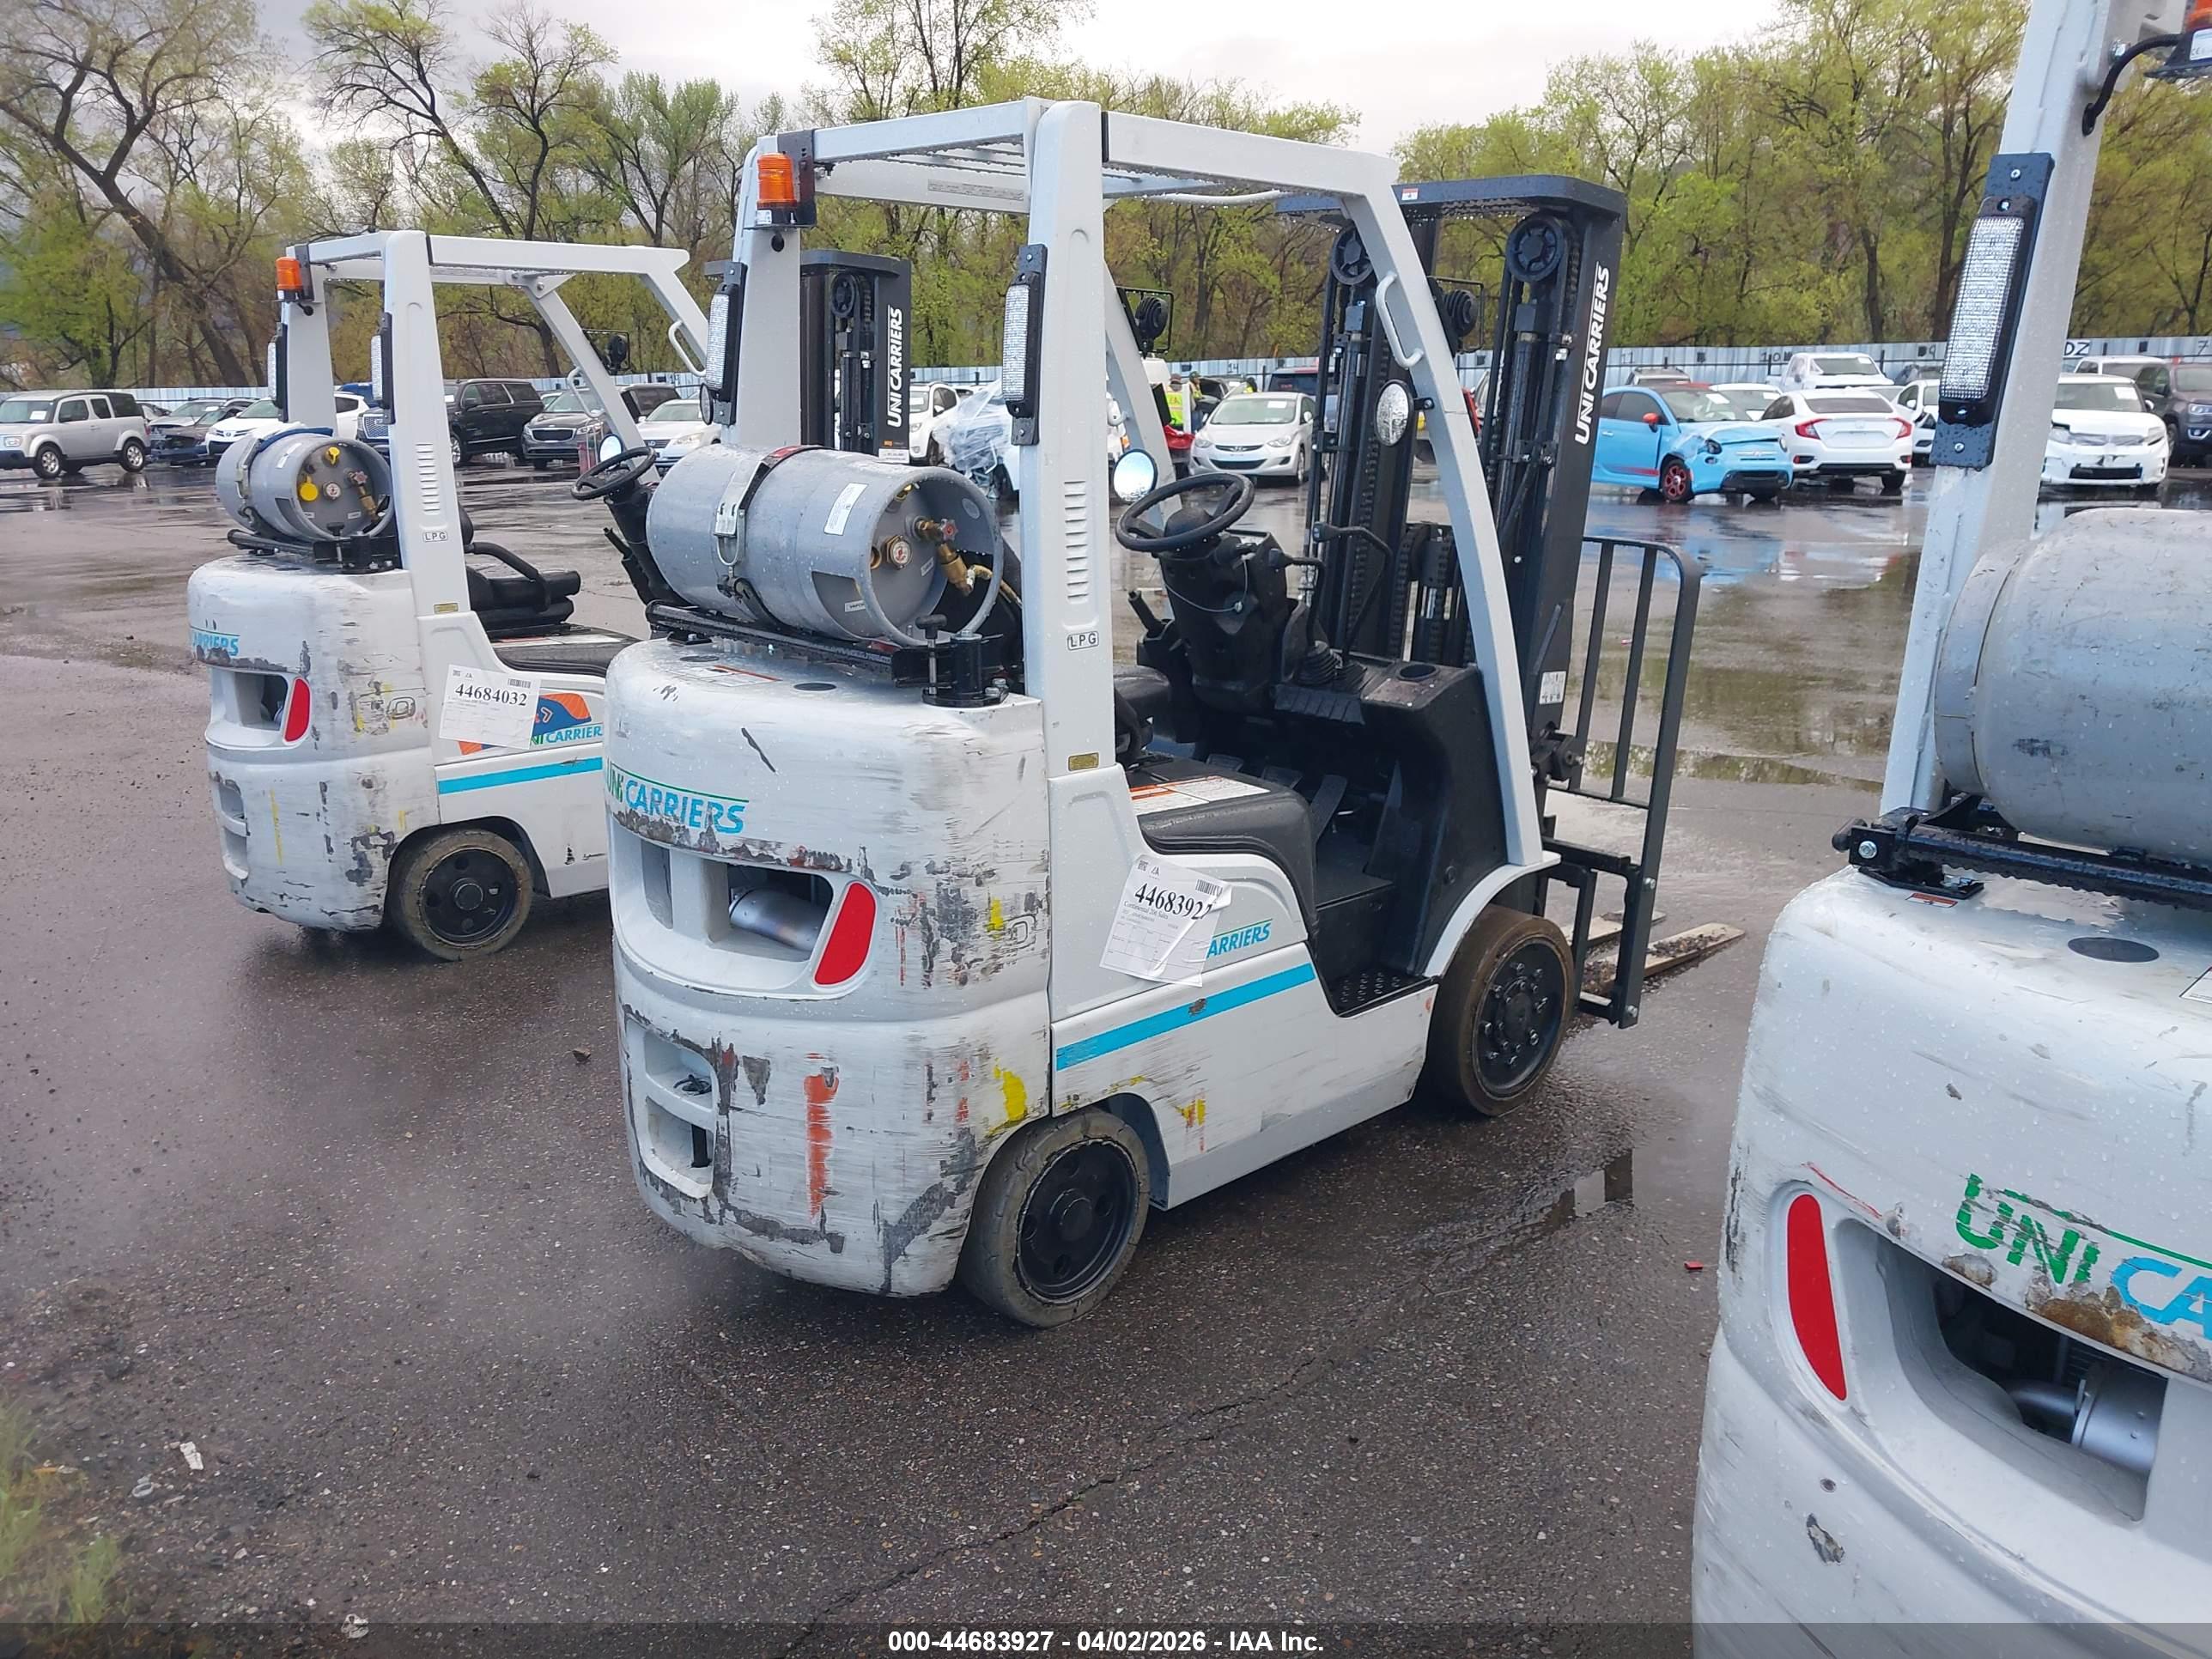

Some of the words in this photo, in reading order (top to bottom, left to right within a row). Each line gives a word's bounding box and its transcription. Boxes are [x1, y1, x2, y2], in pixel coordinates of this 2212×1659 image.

[425, 532, 447, 541] LPG
[1070, 632, 1097, 647] LPG
[455, 684, 528, 707] 44684032
